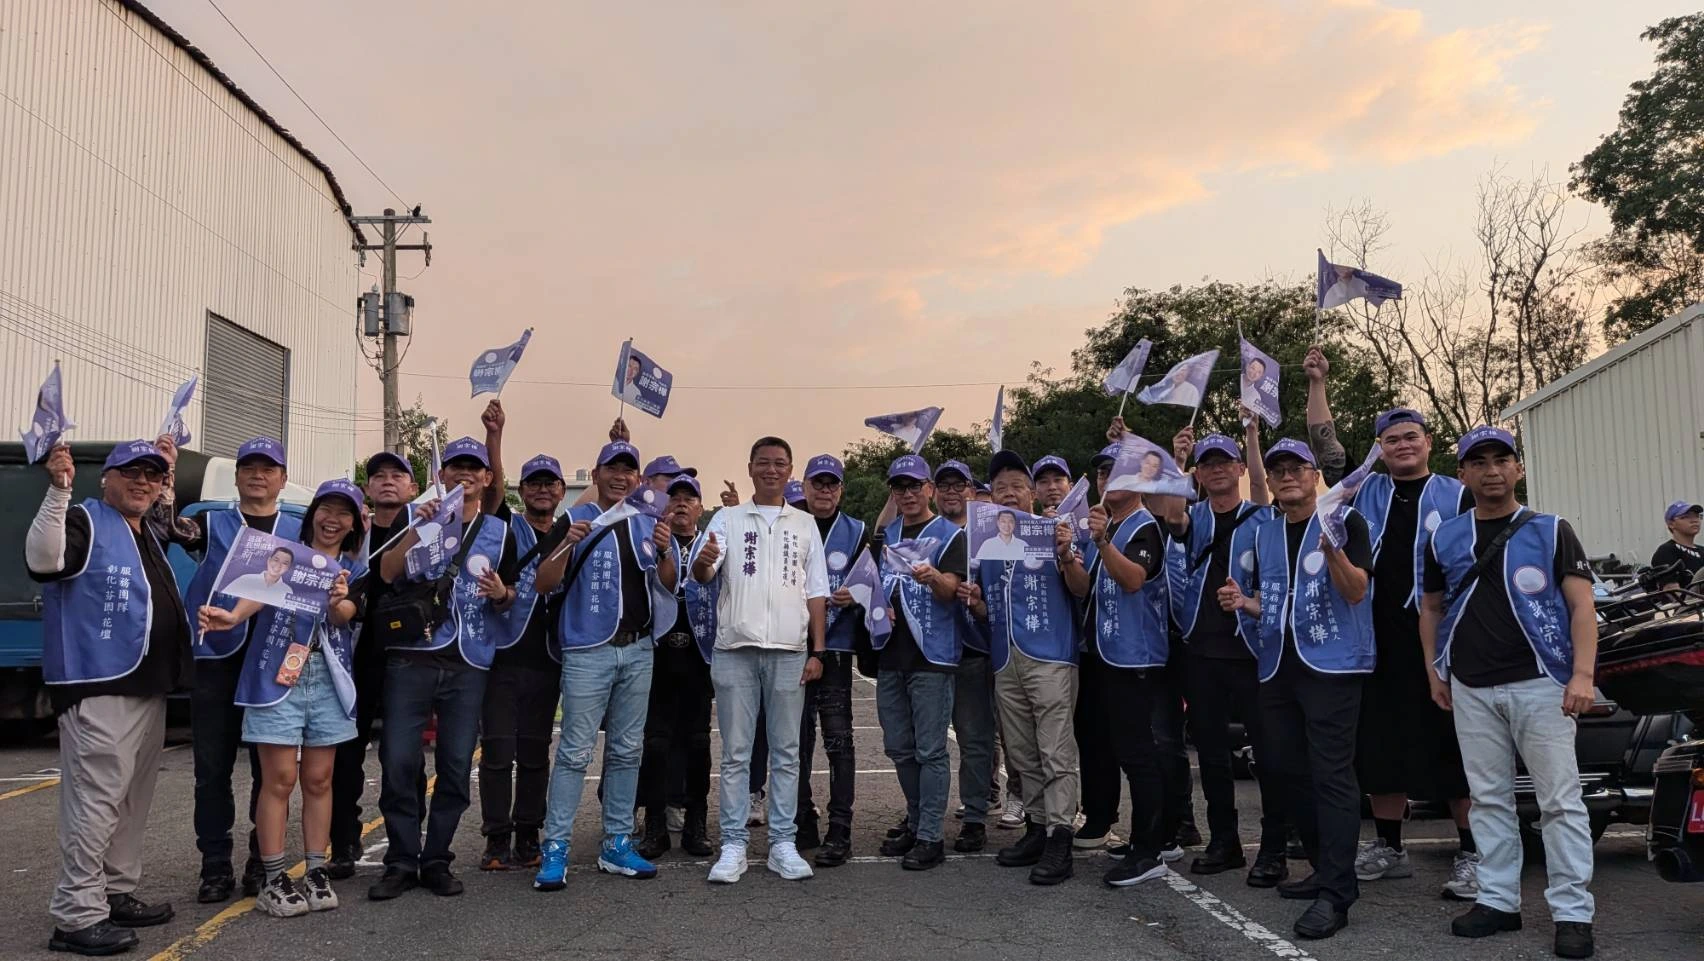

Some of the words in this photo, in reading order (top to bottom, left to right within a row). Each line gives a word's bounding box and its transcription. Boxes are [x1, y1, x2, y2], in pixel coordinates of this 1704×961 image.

[743, 531, 758, 577] 謝宗樺
[1020, 525, 1054, 537] 謝宗樺
[117, 566, 131, 613] 服務團隊
[290, 569, 334, 590] 謝宗樺
[602, 551, 613, 590] 服務團隊
[1024, 574, 1041, 632] 謝宗樺
[1103, 577, 1117, 638] 謝宗樺
[1266, 582, 1280, 624] 服務團隊
[1305, 579, 1328, 644] 謝宗樺
